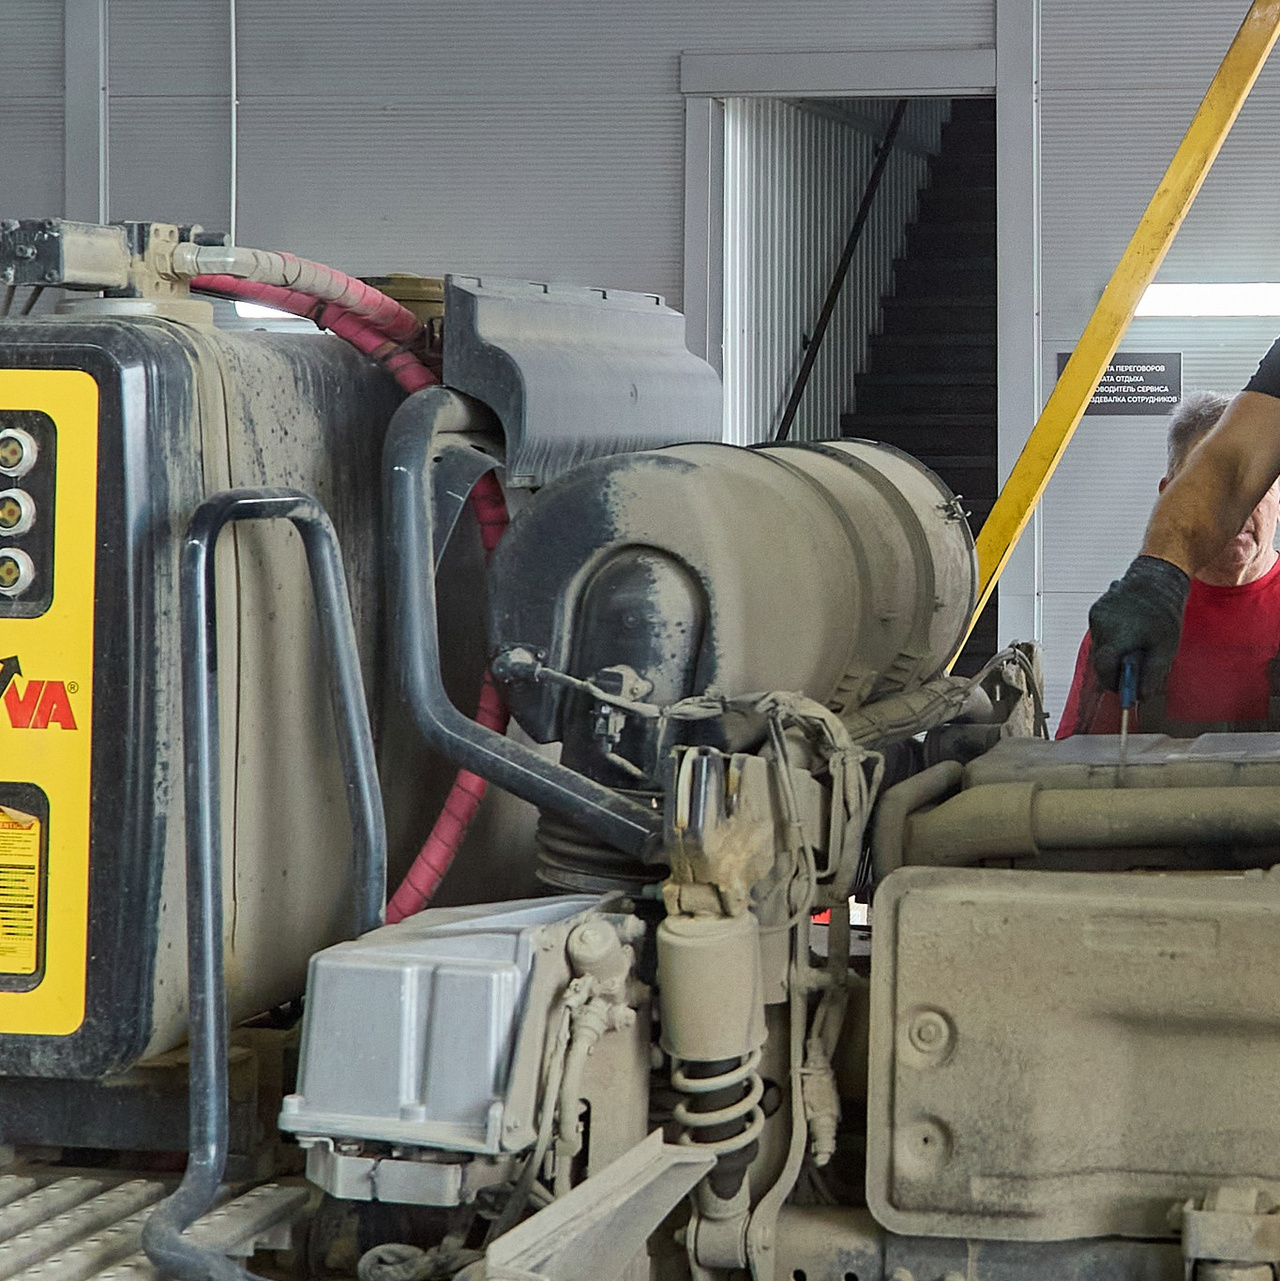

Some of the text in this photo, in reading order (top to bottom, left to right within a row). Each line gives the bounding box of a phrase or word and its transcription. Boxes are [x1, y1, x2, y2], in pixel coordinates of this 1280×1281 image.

[1115, 375, 1145, 383] ОТДЫХА
[1095, 385, 1136, 393] ОВОДИТЕЛЬ
[1089, 396, 1178, 404] ЗДЕВАЛКА СОТРУДНИКОВ
